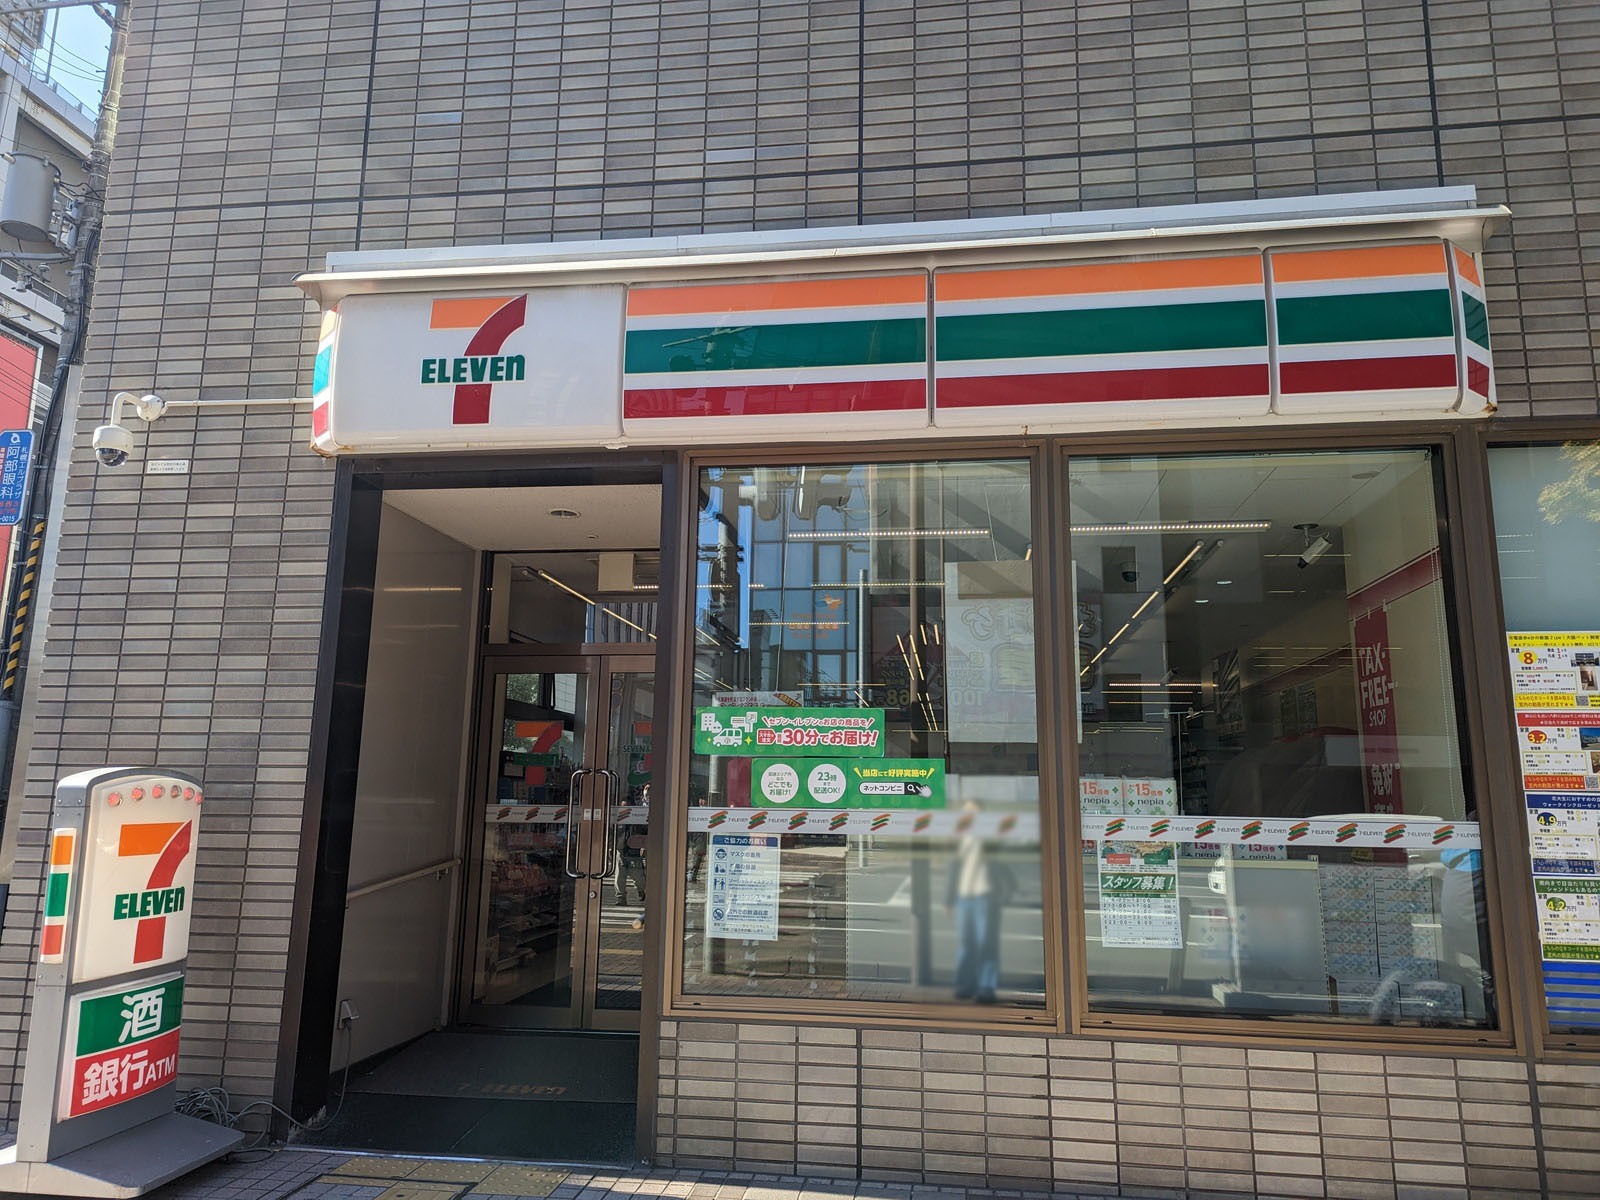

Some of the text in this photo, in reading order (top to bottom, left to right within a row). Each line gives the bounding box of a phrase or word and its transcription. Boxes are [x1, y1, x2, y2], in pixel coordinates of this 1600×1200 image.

[430, 293, 528, 424] 7
[1, 446, 20, 499] 阿部眼科
[1524, 652, 1533, 664] 8
[1361, 675, 1389, 710] FREE
[1528, 734, 1546, 743] 3.2
[817, 772, 837, 781] 23時
[862, 769, 927, 777] 当店にて好評実施中
[1084, 797, 1110, 805] nepia
[1137, 798, 1164, 806] nepia
[1539, 816, 1556, 825] 4.9
[118, 819, 192, 964] 7
[1547, 901, 1565, 911] 4.2
[118, 987, 165, 1044] 酒
